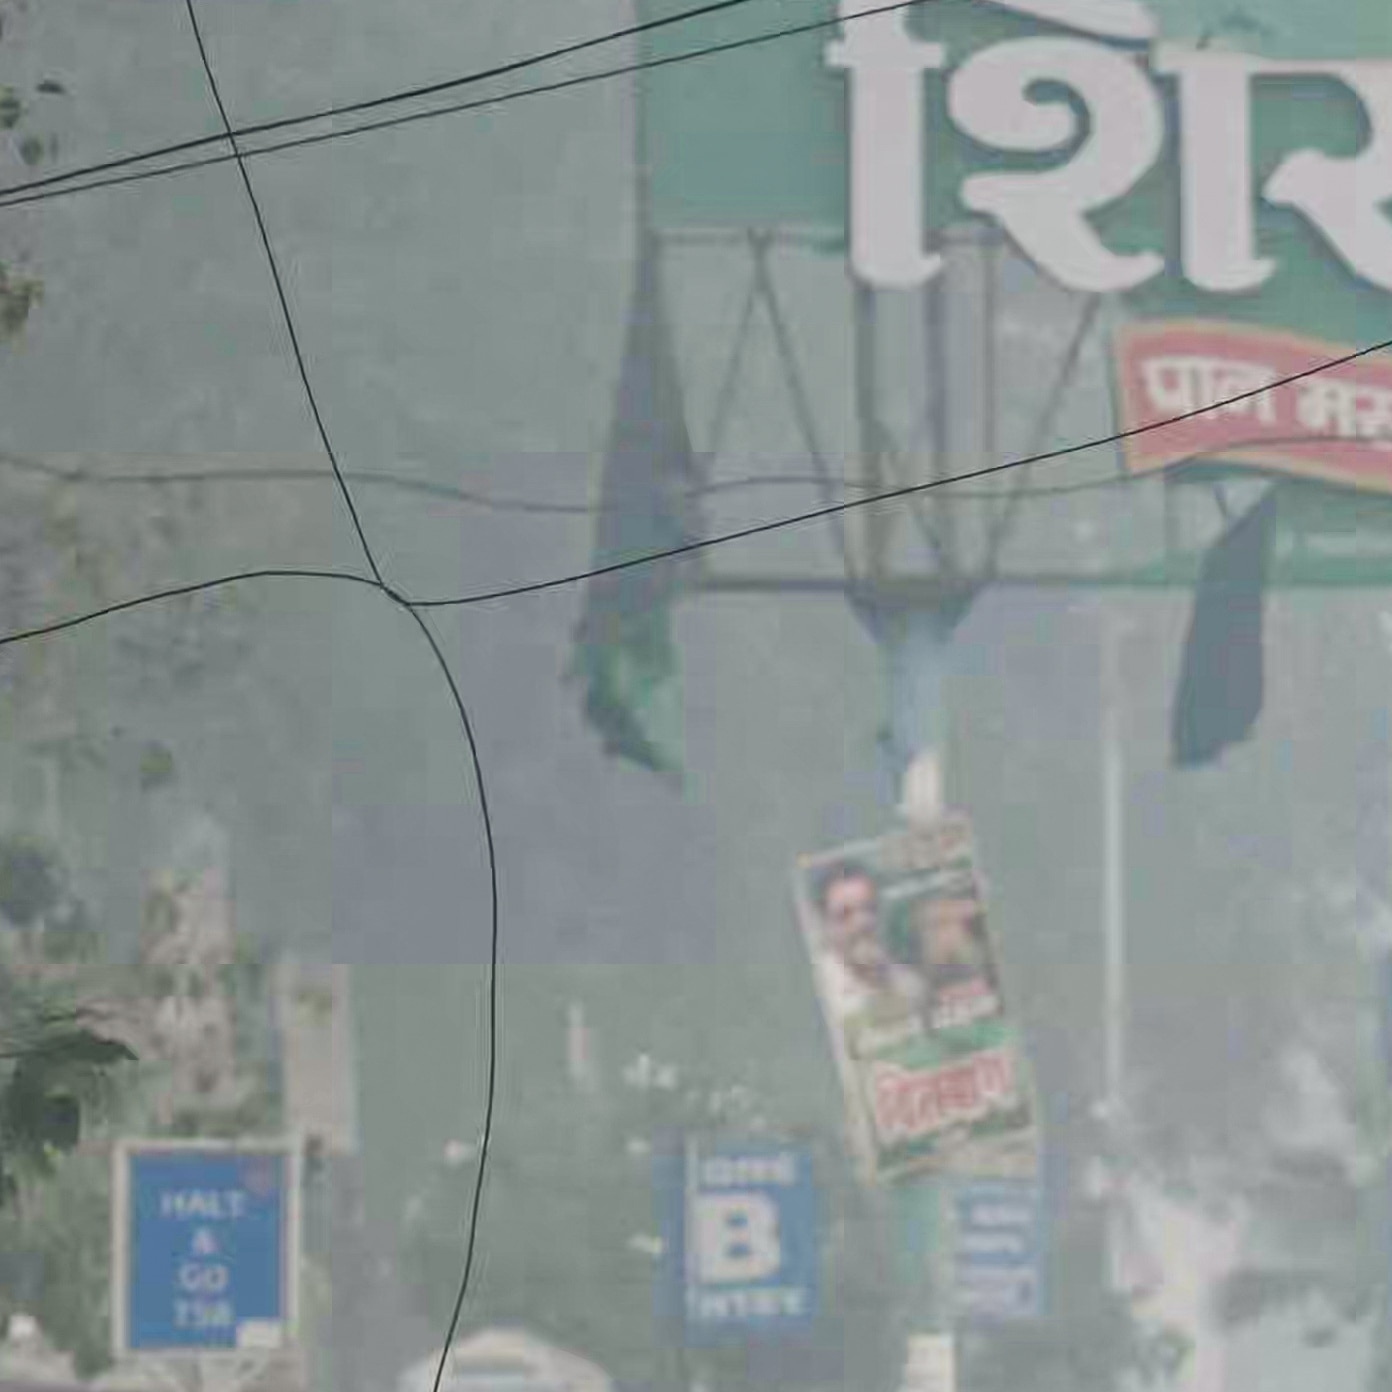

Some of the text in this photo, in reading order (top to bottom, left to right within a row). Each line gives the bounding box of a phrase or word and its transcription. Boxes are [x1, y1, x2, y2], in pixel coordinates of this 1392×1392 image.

[1142, 354, 1279, 425] पान
[160, 1189, 246, 1219] HALT
[690, 1192, 781, 1285] B
[178, 1263, 230, 1292] GO
